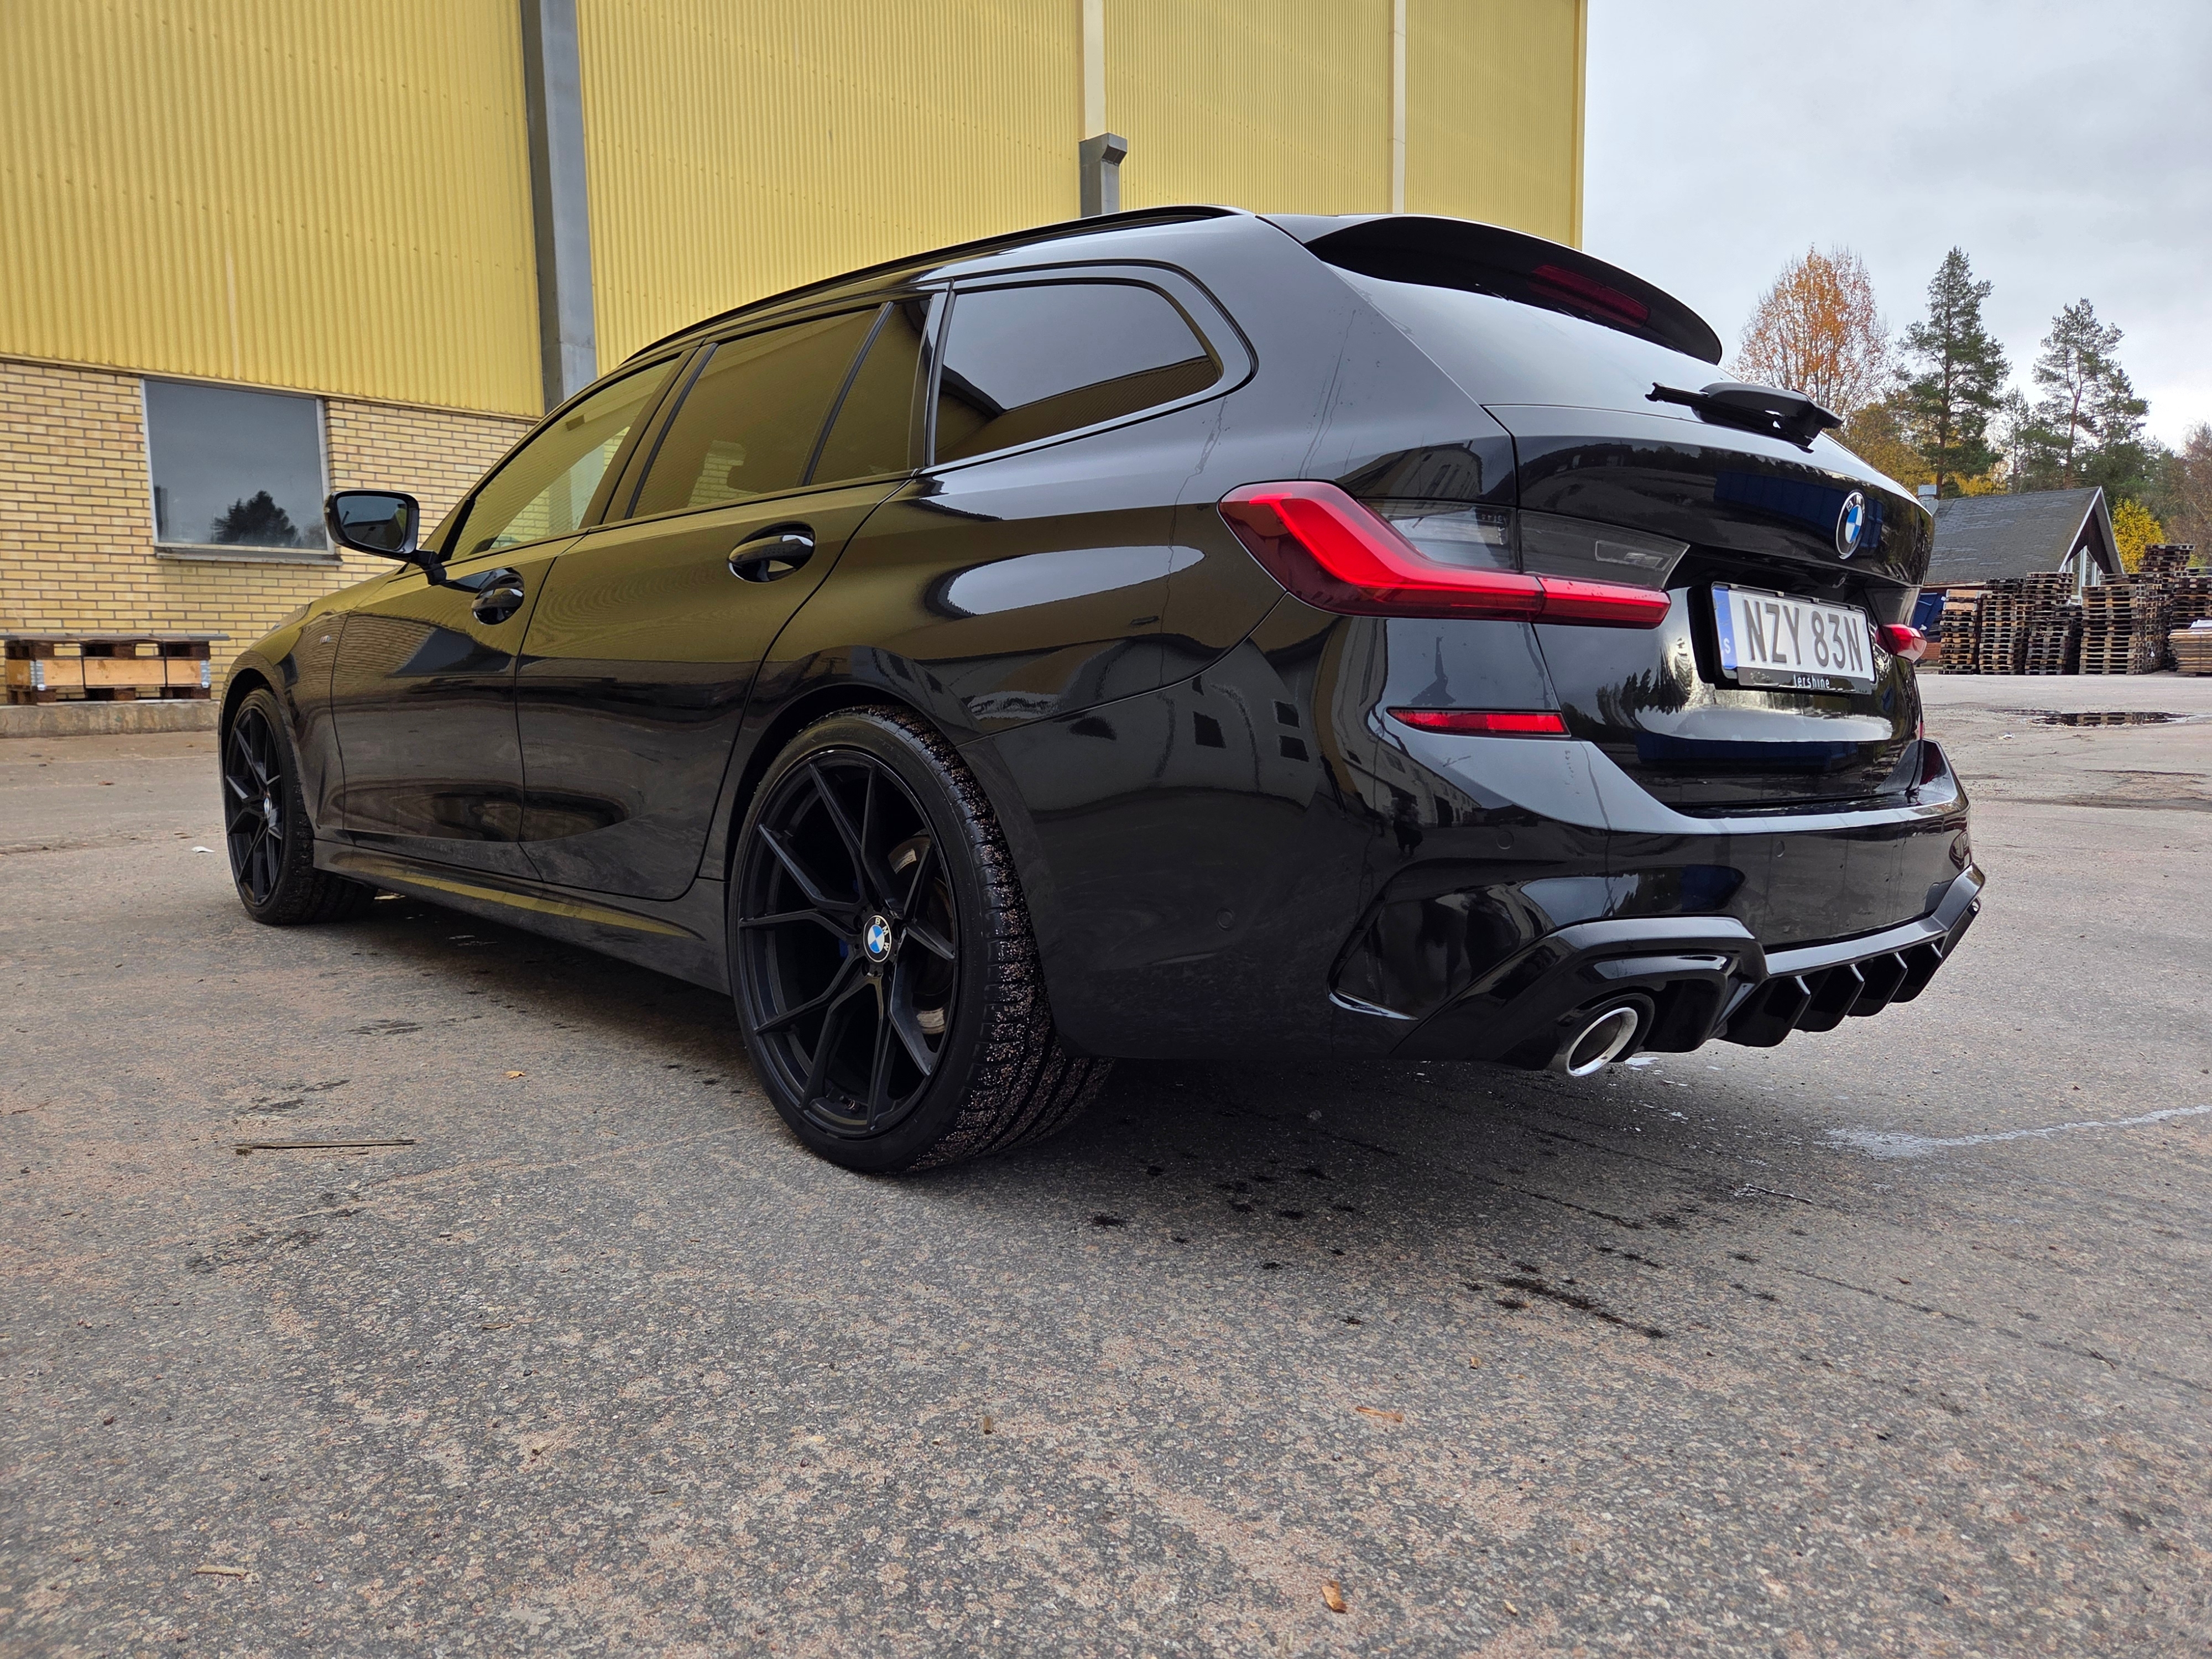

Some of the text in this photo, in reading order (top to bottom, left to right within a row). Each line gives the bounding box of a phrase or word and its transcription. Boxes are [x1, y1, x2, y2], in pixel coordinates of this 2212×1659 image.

[1724, 638, 1731, 654] S
[1744, 599, 1863, 672] NZY 83N
[875, 917, 889, 951] BMW
